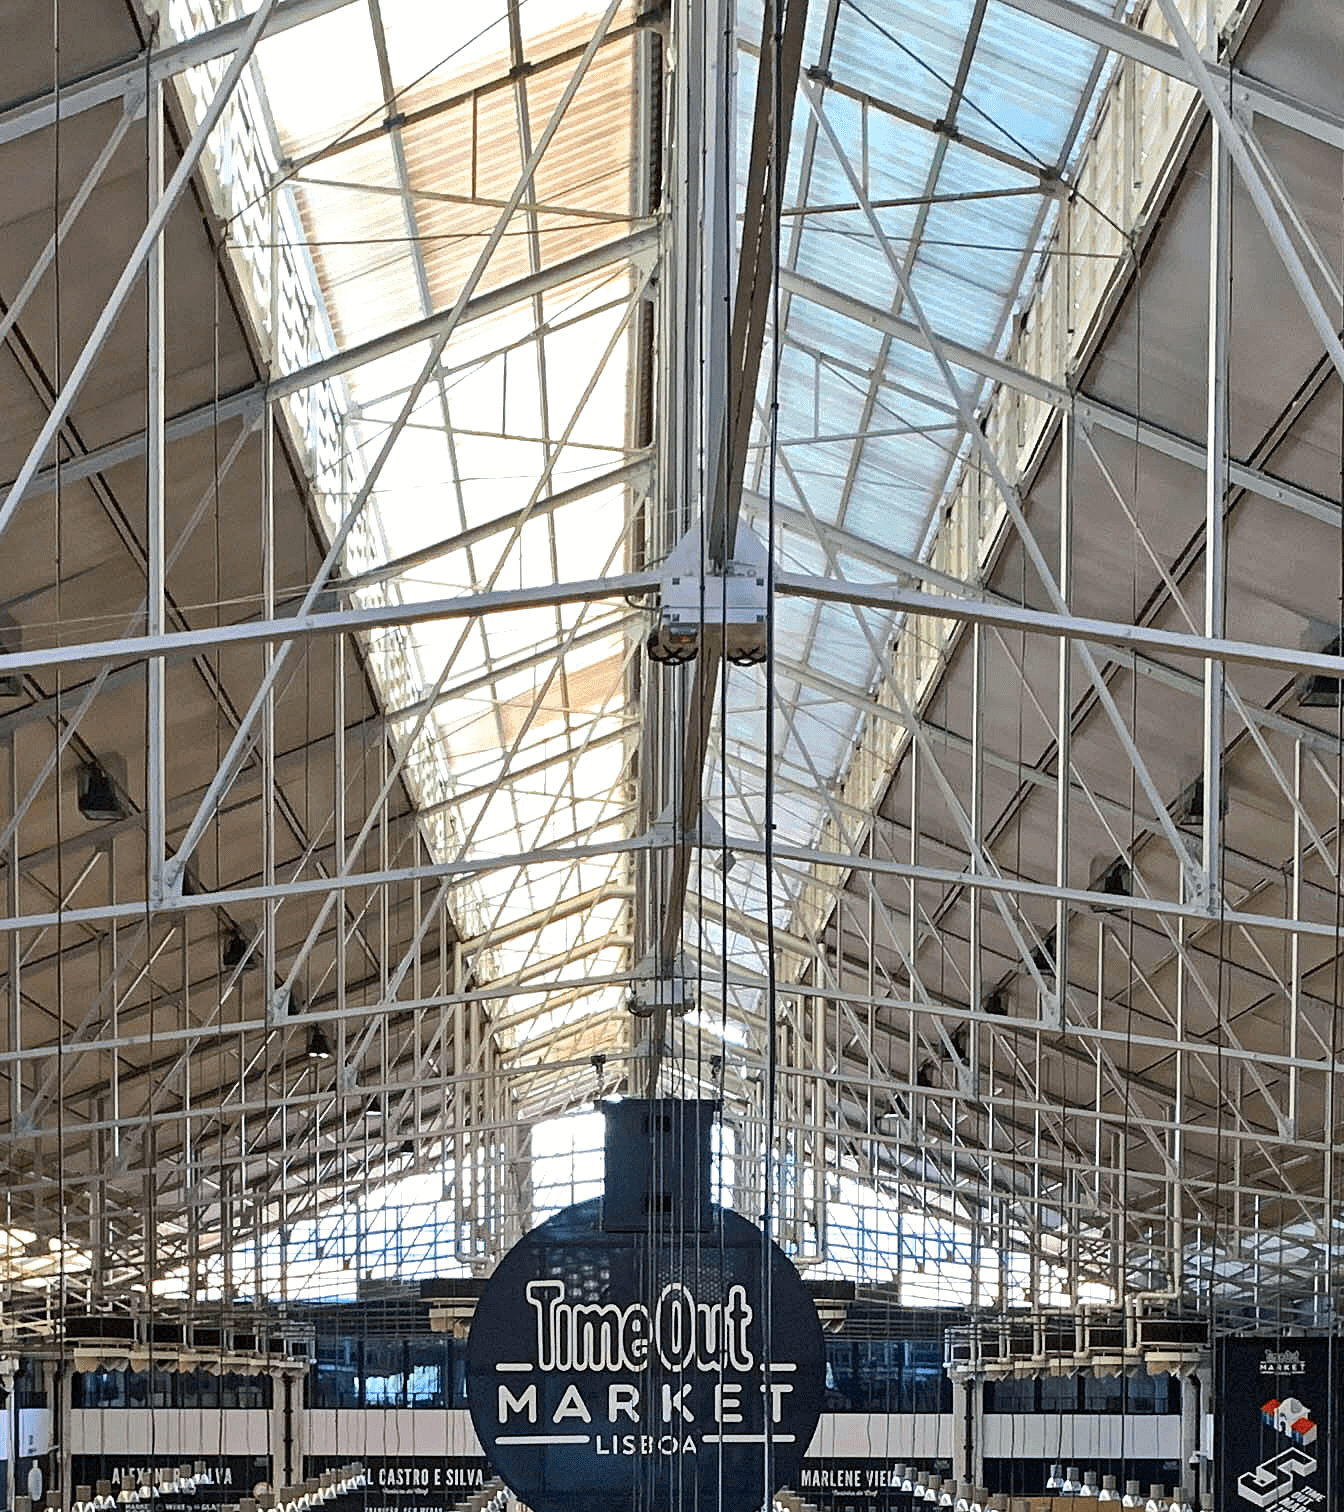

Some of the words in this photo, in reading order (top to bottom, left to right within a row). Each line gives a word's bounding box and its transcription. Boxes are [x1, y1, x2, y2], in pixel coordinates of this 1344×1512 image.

[498, 1383, 794, 1424] MARKET
[596, 1434, 698, 1457] LISBOA
[379, 1468, 428, 1486] CASTRO
[434, 1468, 441, 1486] E
[446, 1468, 483, 1486] SILVA
[801, 1470, 861, 1487] MARLENE
[1291, 1491, 1314, 1505] OUT
[1301, 1485, 1326, 1502] TIME
